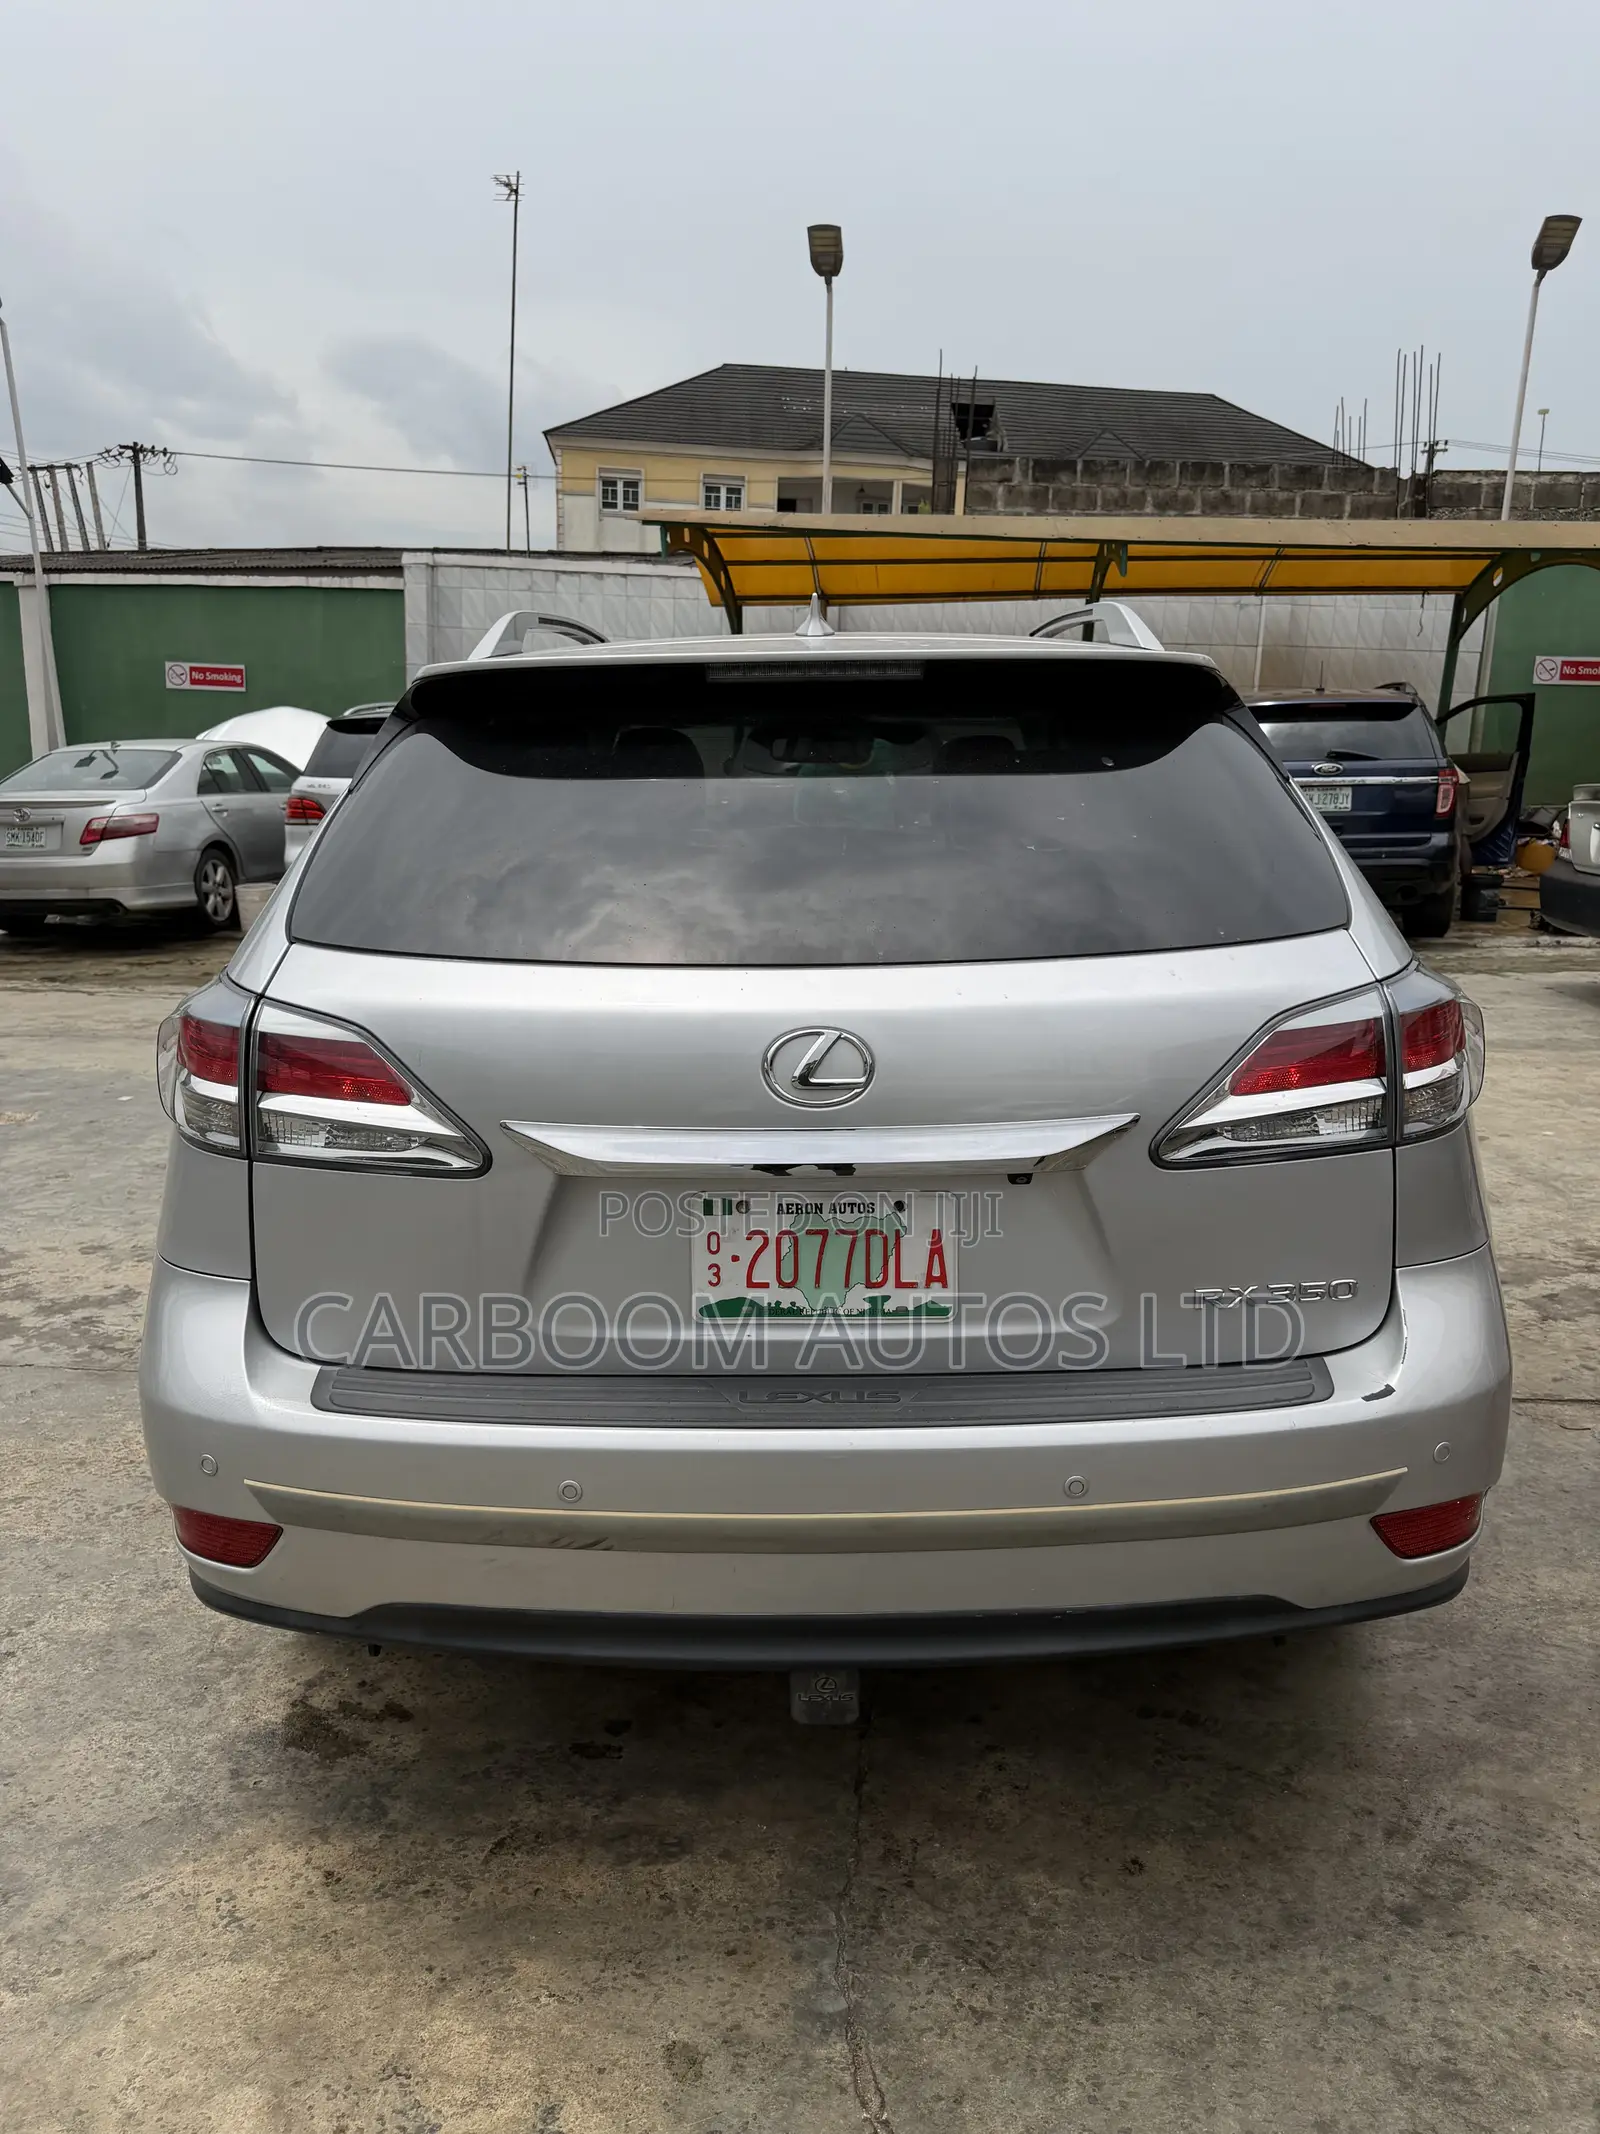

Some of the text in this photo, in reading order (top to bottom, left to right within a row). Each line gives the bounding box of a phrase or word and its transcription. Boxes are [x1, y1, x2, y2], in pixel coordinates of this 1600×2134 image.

[1562, 665, 1576, 675] No
[191, 671, 242, 684] No Smoking
[776, 1202, 876, 1215] AERON AUTOS
[1194, 1278, 1359, 1310] RX 350
[738, 1390, 902, 1404] LEXUS
[797, 1692, 855, 1703] LEXUS
